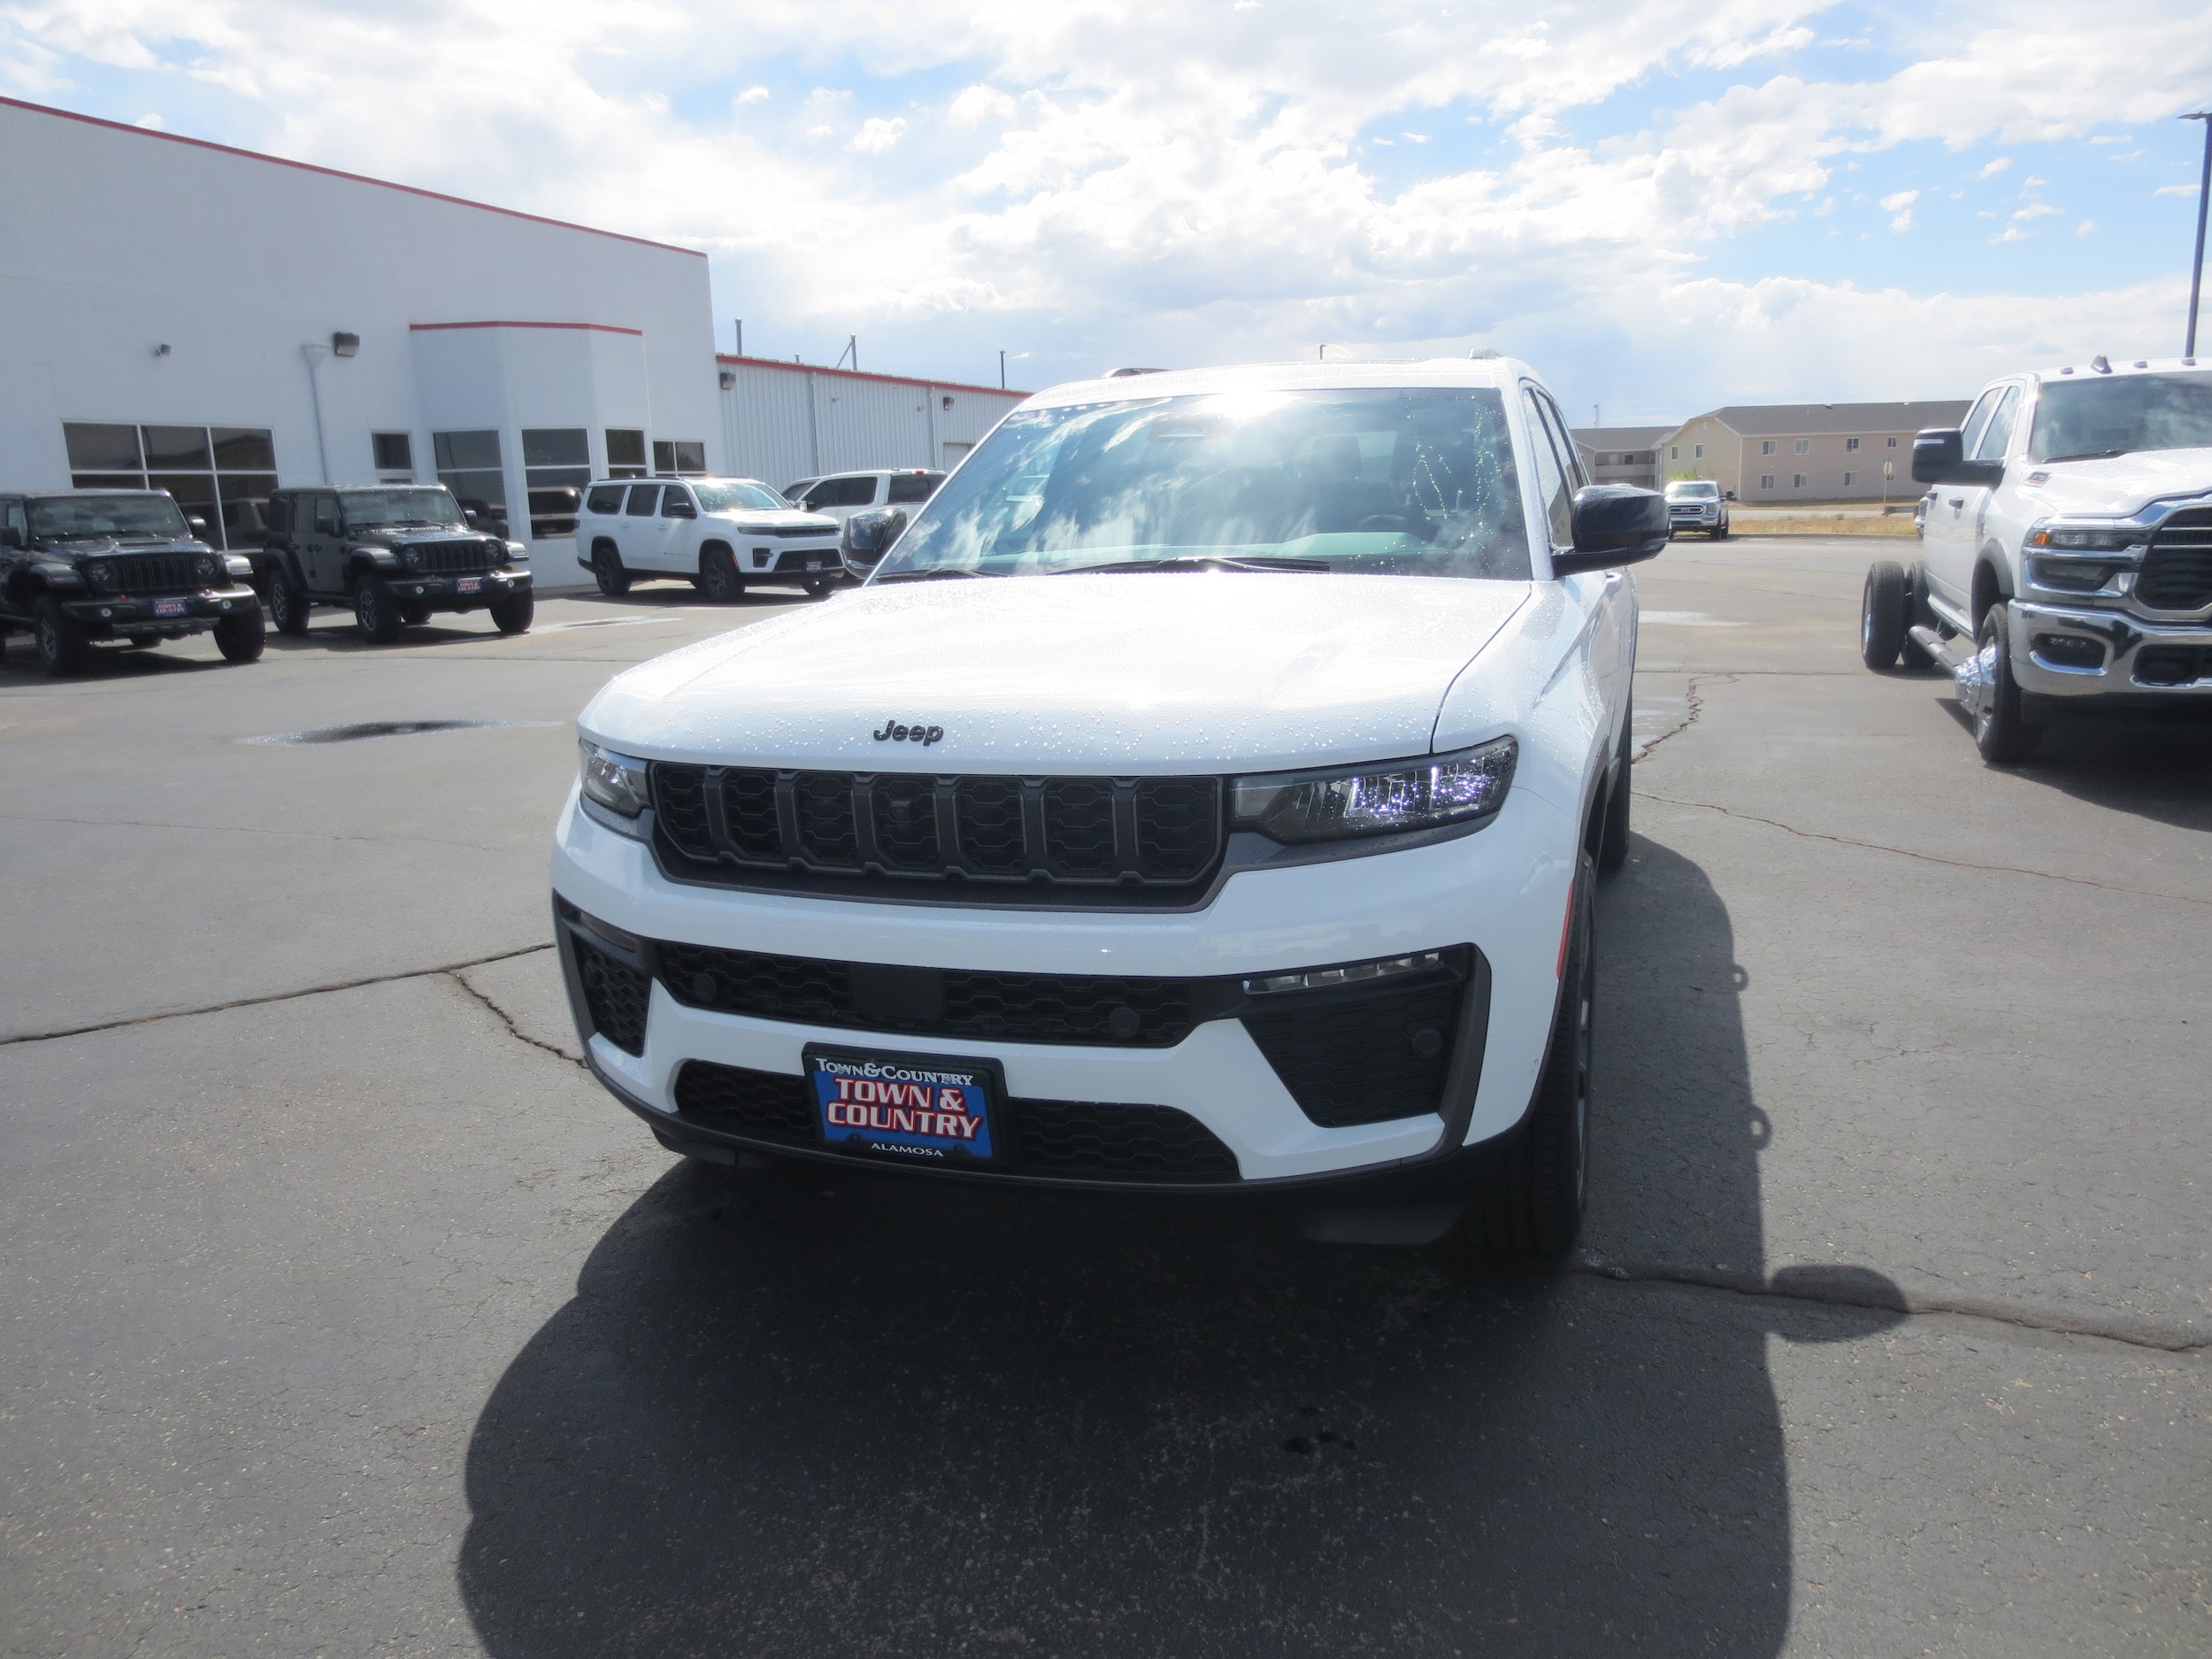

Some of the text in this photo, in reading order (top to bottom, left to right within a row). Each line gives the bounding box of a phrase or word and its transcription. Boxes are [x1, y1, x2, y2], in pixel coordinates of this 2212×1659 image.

[873, 720, 944, 747] Jeep
[834, 1078, 965, 1111] TOWN &
[826, 1102, 983, 1139] COUNTRY
[871, 1142, 944, 1157] ALAMOSA
